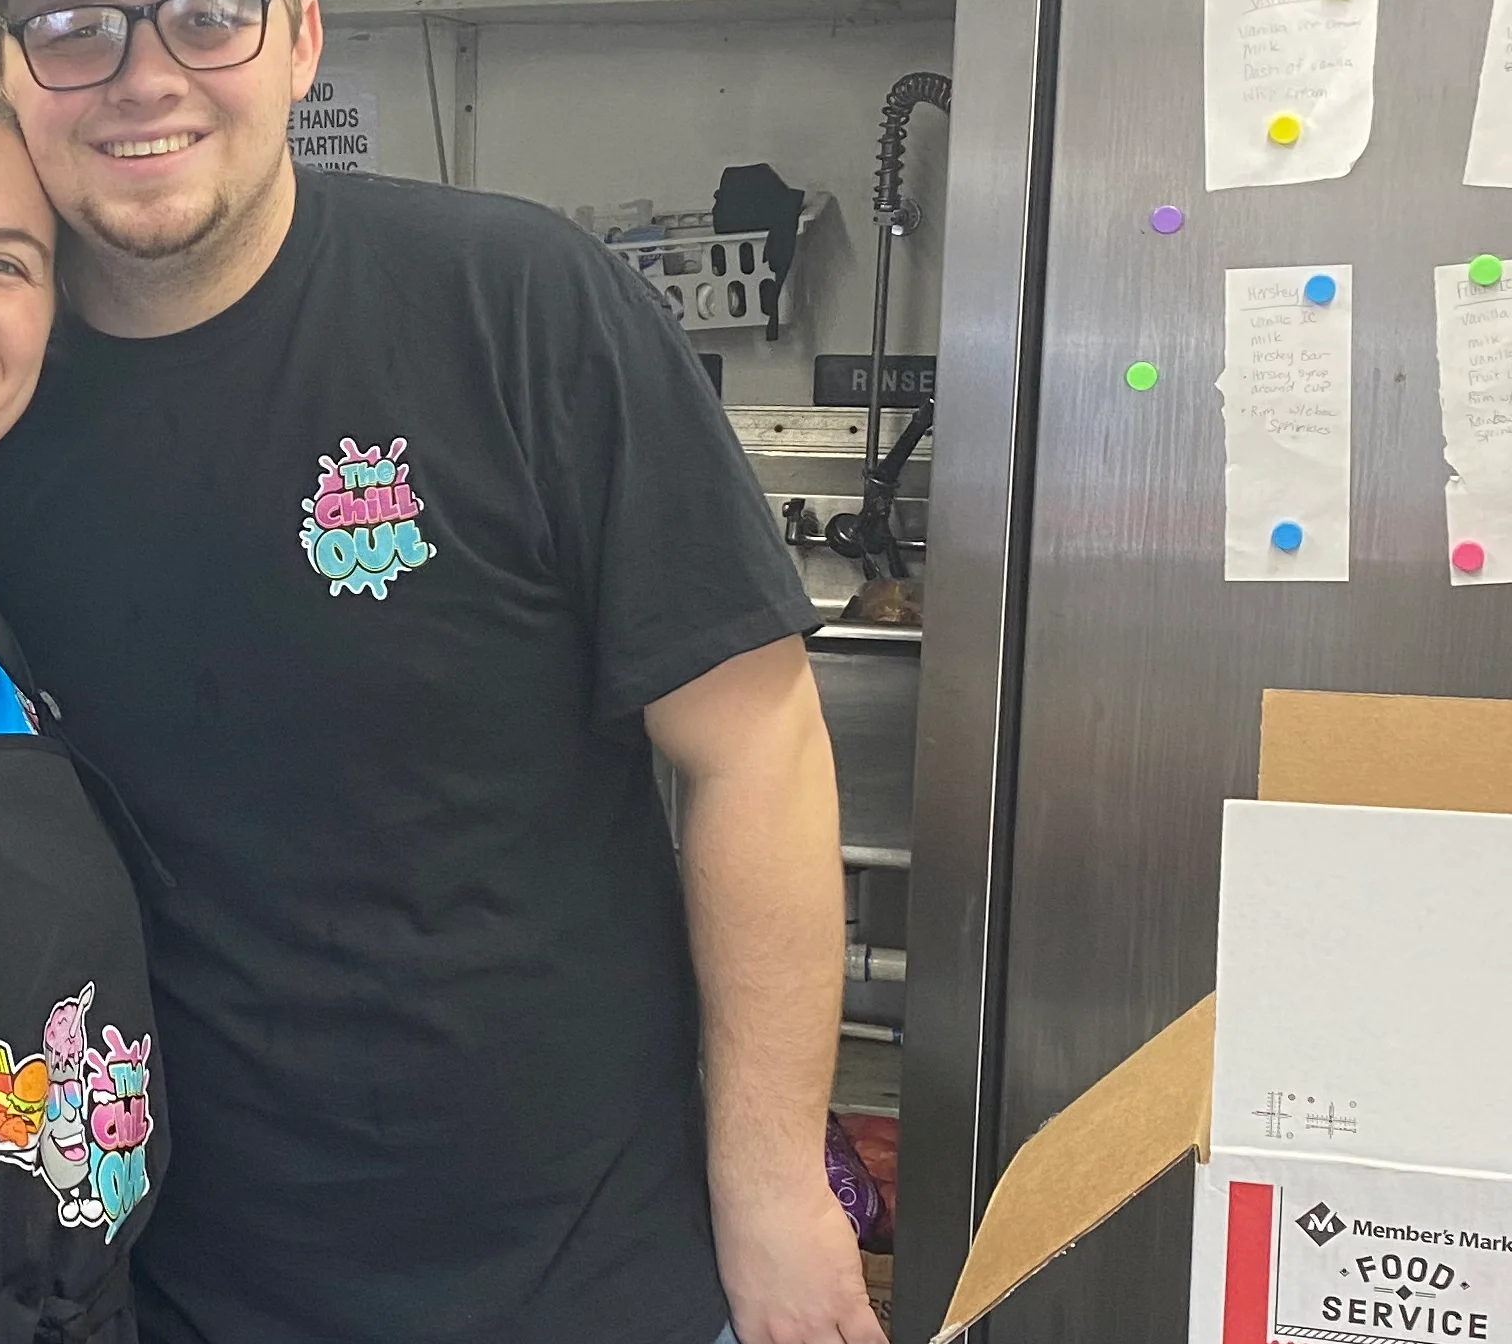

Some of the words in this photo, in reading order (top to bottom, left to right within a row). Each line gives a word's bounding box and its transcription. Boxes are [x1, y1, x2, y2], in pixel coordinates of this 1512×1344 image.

[304, 83, 334, 103] ND
[299, 108, 359, 130] HANDS
[287, 134, 368, 156] STARTING
[1248, 283, 1300, 303] Hershey
[851, 369, 934, 393] RNSE
[340, 459, 397, 490] The
[1352, 1219, 1455, 1246] Member's
[1355, 1254, 1455, 1291] FOOD
[1321, 1295, 1489, 1341] SERVICE
